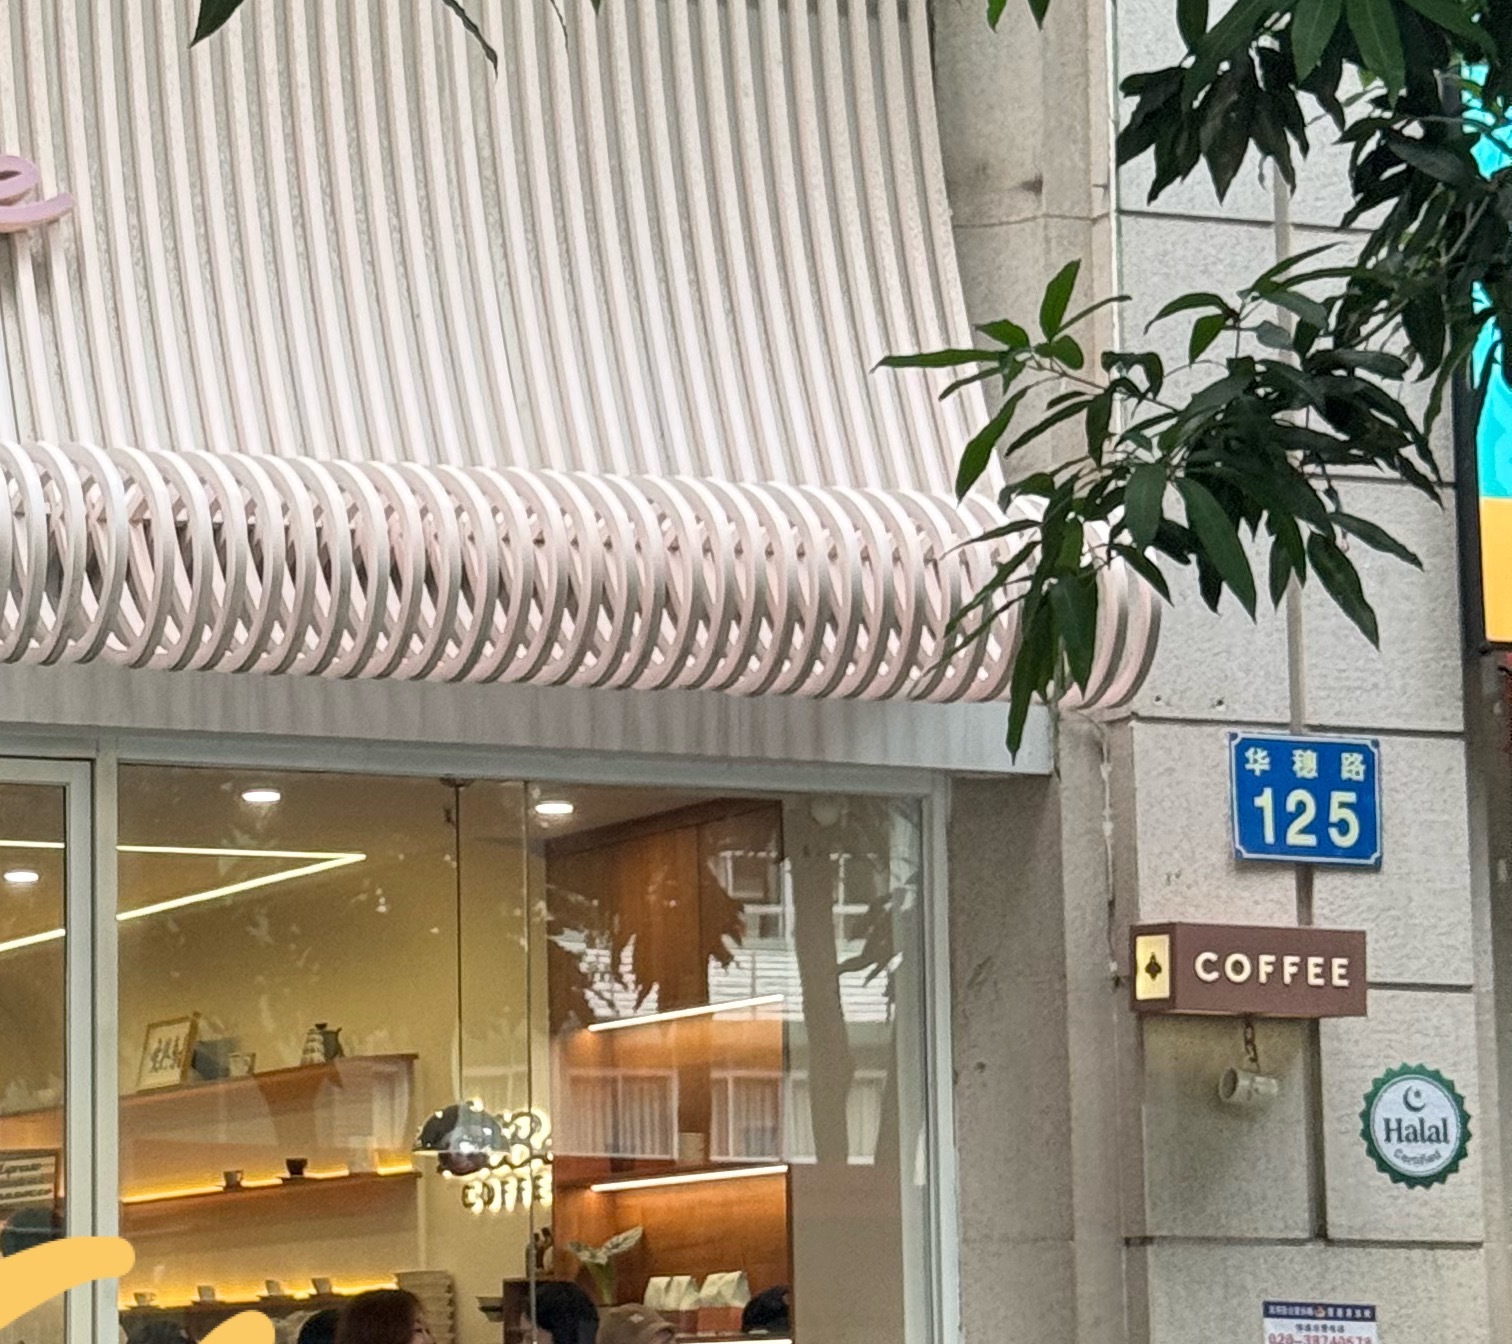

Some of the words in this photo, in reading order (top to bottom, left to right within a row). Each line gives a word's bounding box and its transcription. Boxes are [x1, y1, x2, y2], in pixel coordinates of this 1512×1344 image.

[1244, 746, 1366, 782] 华穗路
[1253, 787, 1360, 848] 125
[1194, 951, 1351, 987] COFFEE
[1383, 1116, 1450, 1144] Halal
[461, 1174, 553, 1209] COFFE
